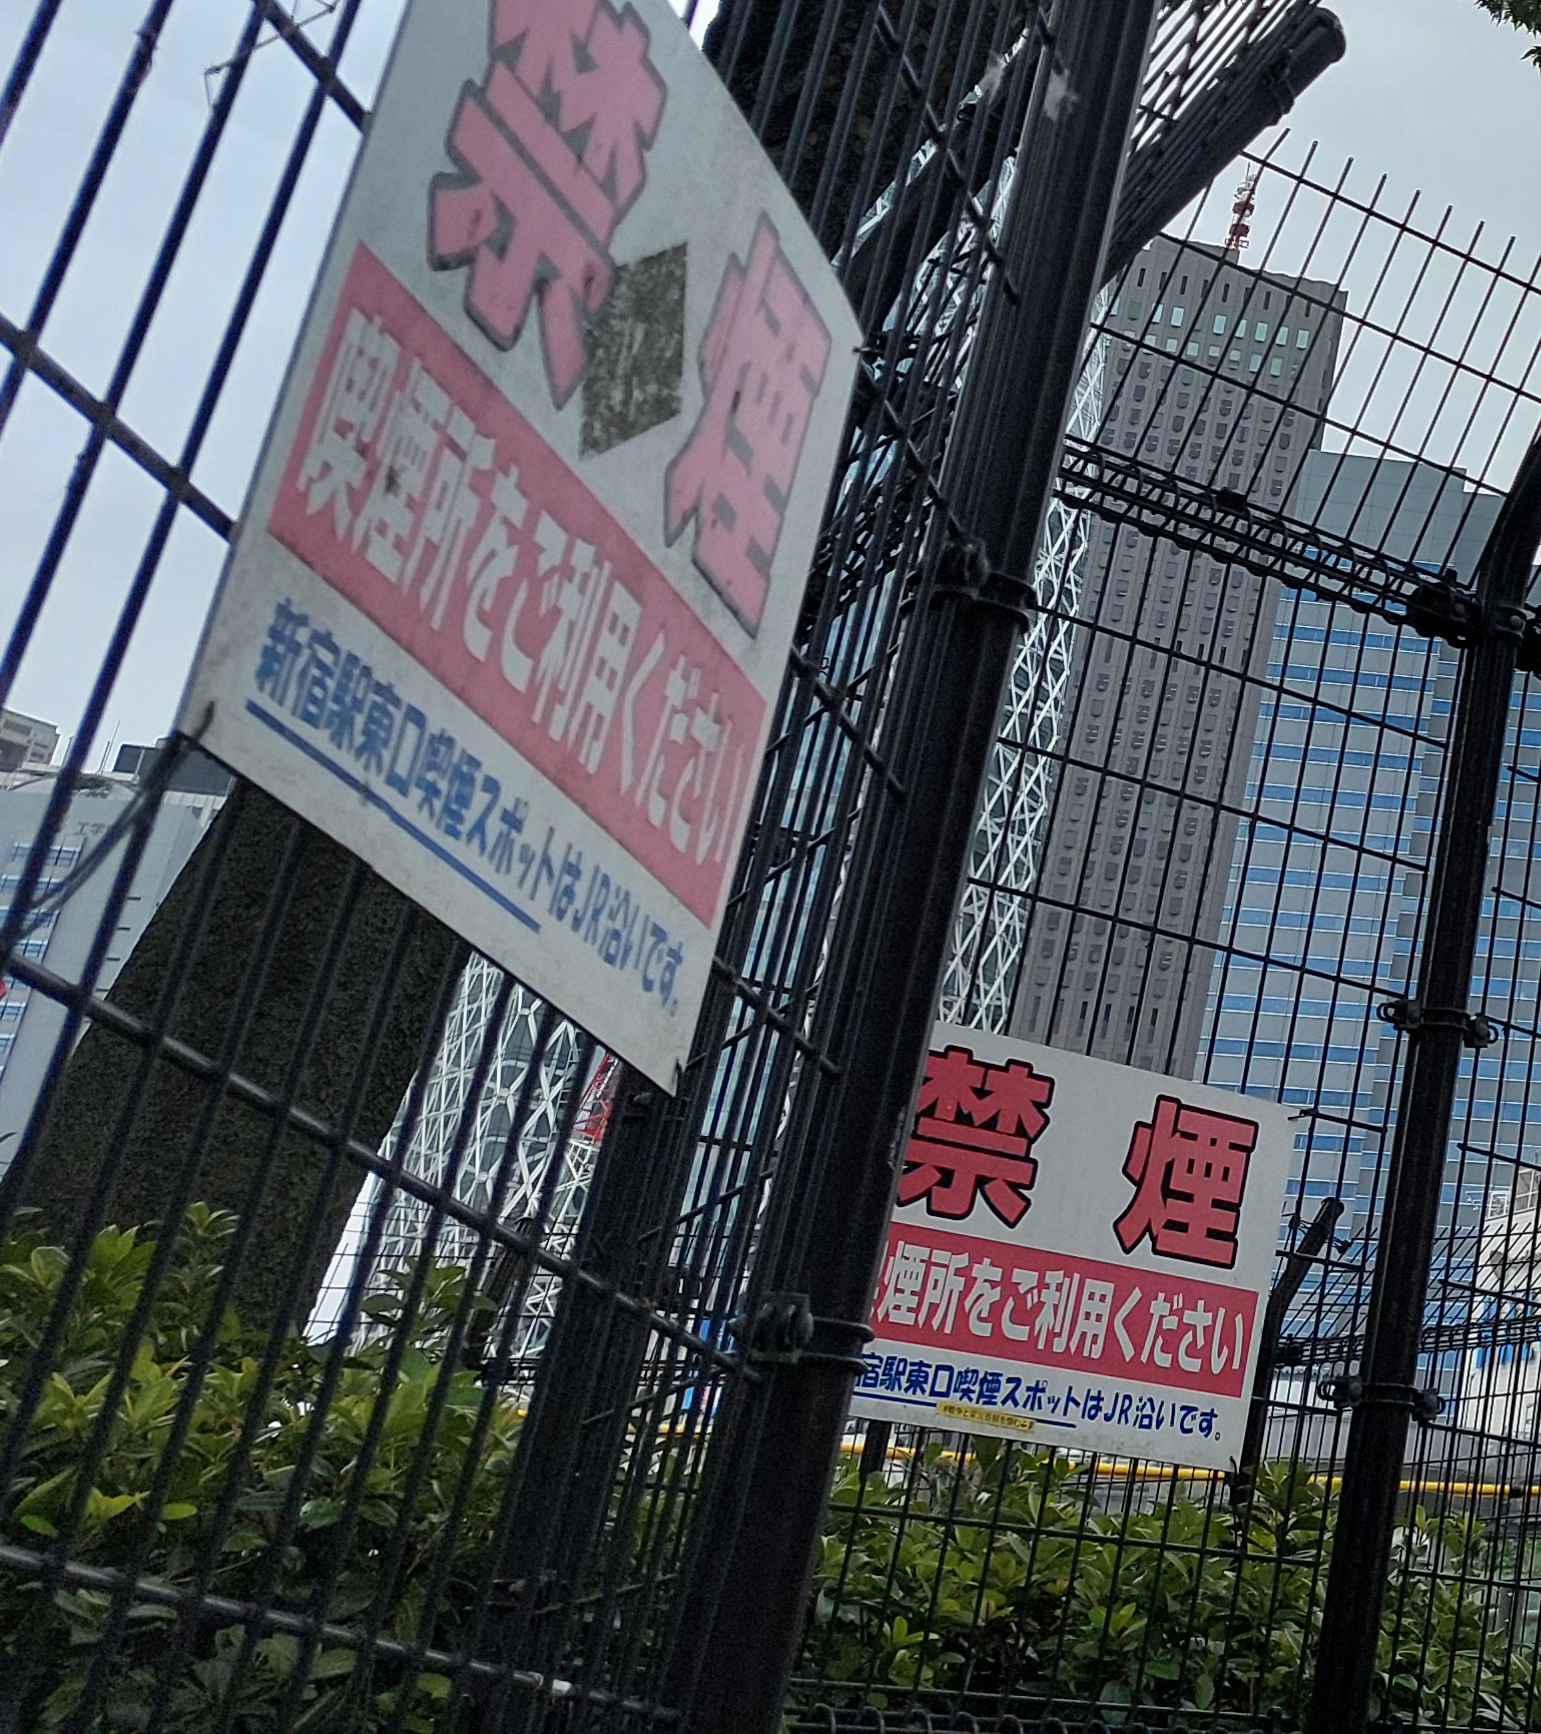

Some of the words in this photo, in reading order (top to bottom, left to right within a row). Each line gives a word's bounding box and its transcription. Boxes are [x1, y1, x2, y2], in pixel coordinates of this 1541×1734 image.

[297, 306, 747, 868] 喫煙所をご利用ください
[897, 1044, 1259, 1270] 禁煙
[855, 1351, 1224, 1443] 宿駅東口喫煙スポットはJR沿いです。
[870, 1237, 1244, 1376] 煙所をご利用ください
